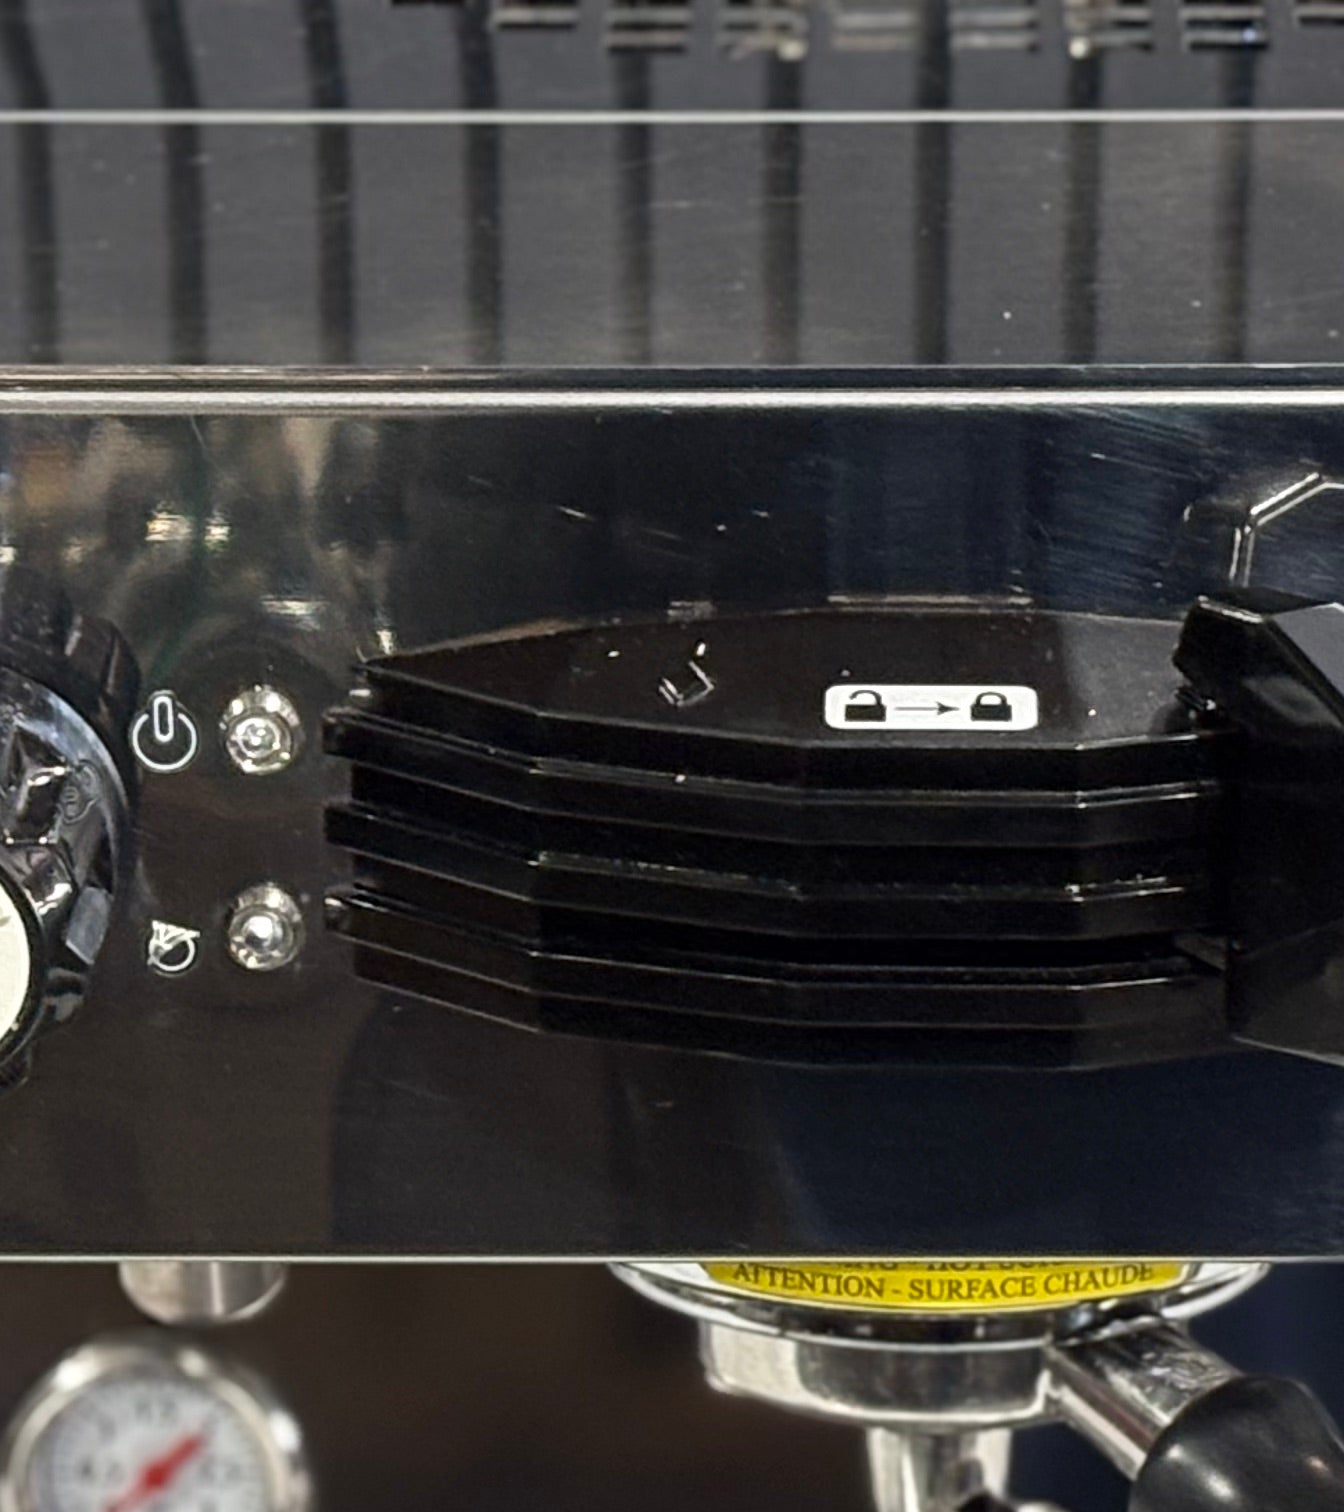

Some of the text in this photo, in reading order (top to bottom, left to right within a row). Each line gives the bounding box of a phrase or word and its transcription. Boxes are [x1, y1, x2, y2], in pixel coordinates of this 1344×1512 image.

[733, 1262, 884, 1298] ATTENTION
[908, 1275, 1036, 1301] SURFACE
[1043, 1262, 1154, 1296] CHAUDE
